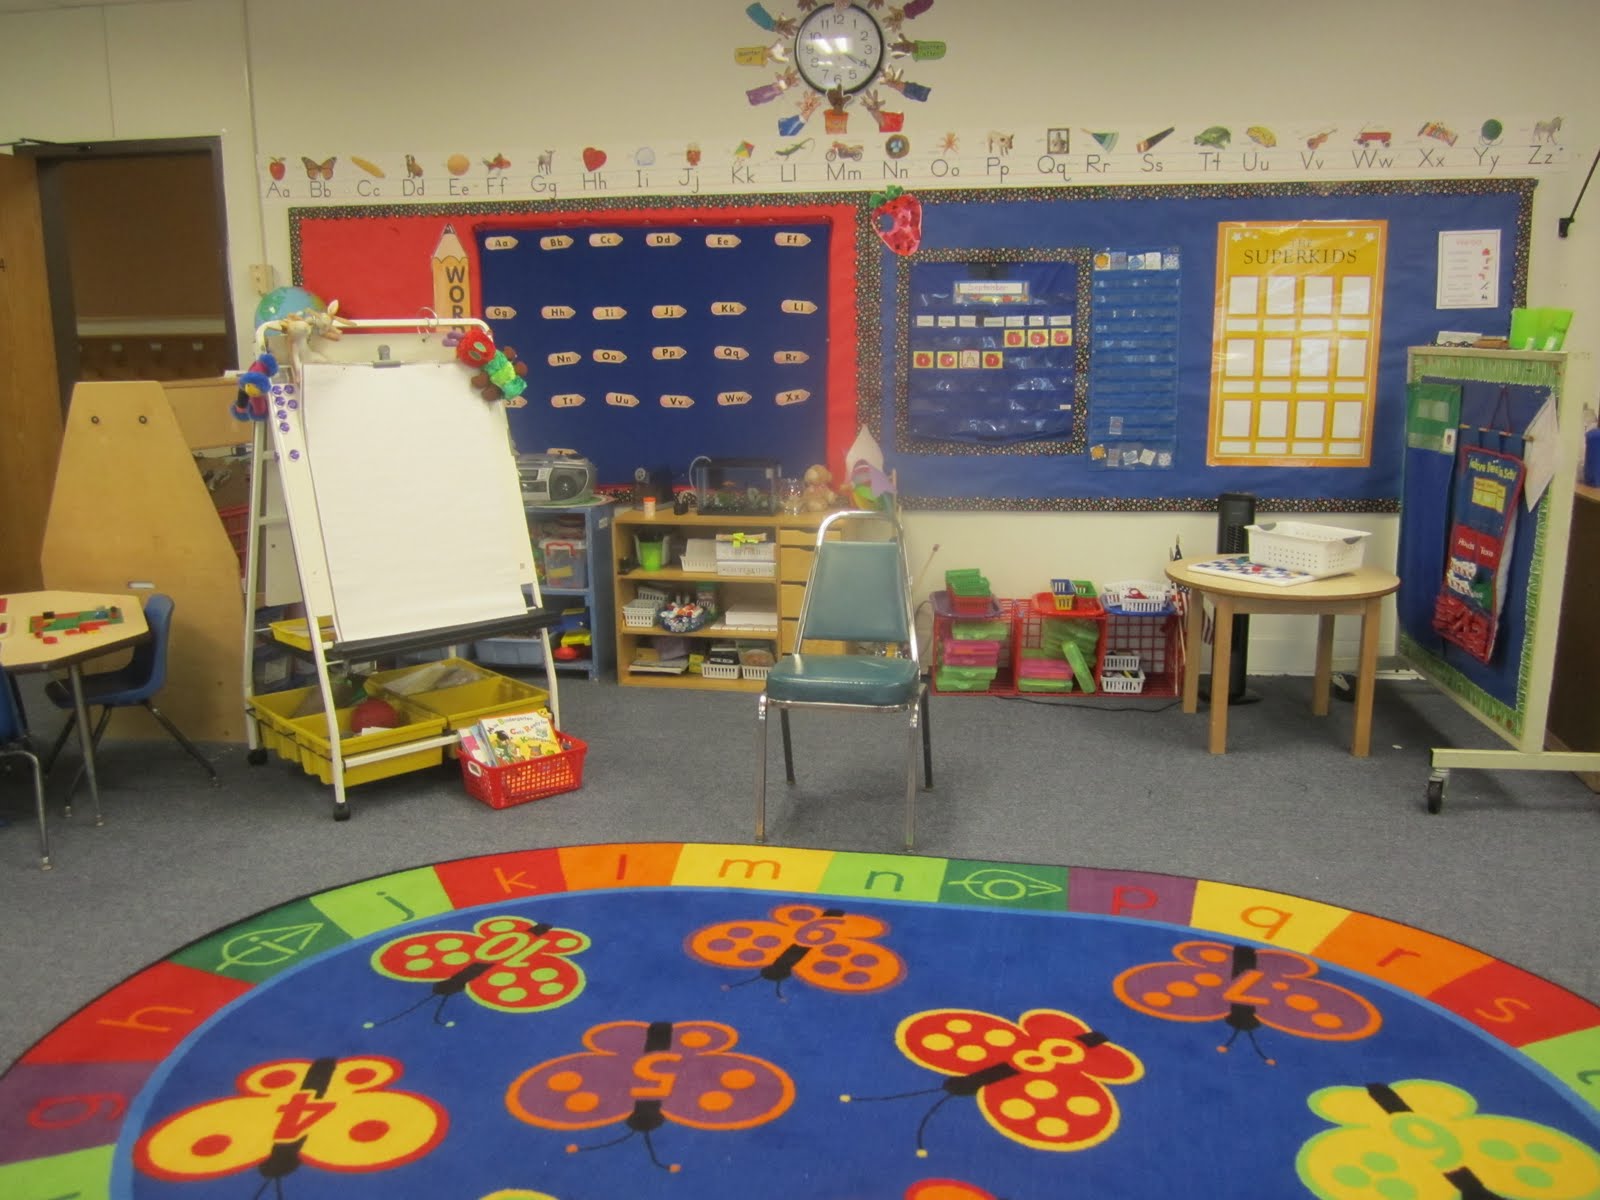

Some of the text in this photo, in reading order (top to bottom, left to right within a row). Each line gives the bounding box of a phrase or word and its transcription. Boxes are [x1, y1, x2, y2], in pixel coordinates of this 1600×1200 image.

[821, 19, 829, 29] 11
[833, 15, 845, 25] 12
[852, 19, 857, 28] 1
[860, 31, 869, 41] 2
[864, 45, 873, 55] 3
[822, 69, 829, 79] 7
[849, 69, 857, 80] 5
[266, 145, 1553, 199] Aa Bb Cc Dd Ee Ff Gg Hh Ii Jj Kk Ll Mm Nn Oo Pp Qq Rr Ss Tt Uu Vv Ww Xx Yy Zz
[550, 239, 563, 247] Bb
[601, 236, 612, 244] Cc
[656, 236, 670, 244] Dd
[717, 237, 729, 245] Ee
[787, 235, 798, 244] Ff
[1243, 249, 1357, 265] SUPERKIDS
[664, 307, 674, 316] Jj
[721, 304, 735, 313] Kk
[794, 303, 804, 311] Ll
[494, 309, 507, 318] Gg
[605, 309, 614, 317] Ii
[602, 352, 617, 361] Oo
[662, 348, 675, 357] Pp
[724, 348, 739, 359] Qq
[786, 353, 797, 361] Rr
[557, 355, 572, 363] Nn
[562, 397, 573, 405] Tt
[615, 396, 629, 404] Uu
[670, 397, 683, 405] Vv
[725, 394, 743, 402] Ww
[785, 393, 800, 401] Xx
[719, 858, 782, 881] m
[494, 868, 536, 895] k
[865, 870, 904, 892] n
[982, 877, 1026, 900] o
[1111, 886, 1158, 915] p
[376, 891, 416, 923] j
[1240, 906, 1293, 940] q
[1376, 946, 1421, 968] r
[1474, 997, 1530, 1024] s
[1013, 1037, 1085, 1072] 8
[630, 1053, 682, 1097] 5
[273, 1093, 337, 1140] 4
